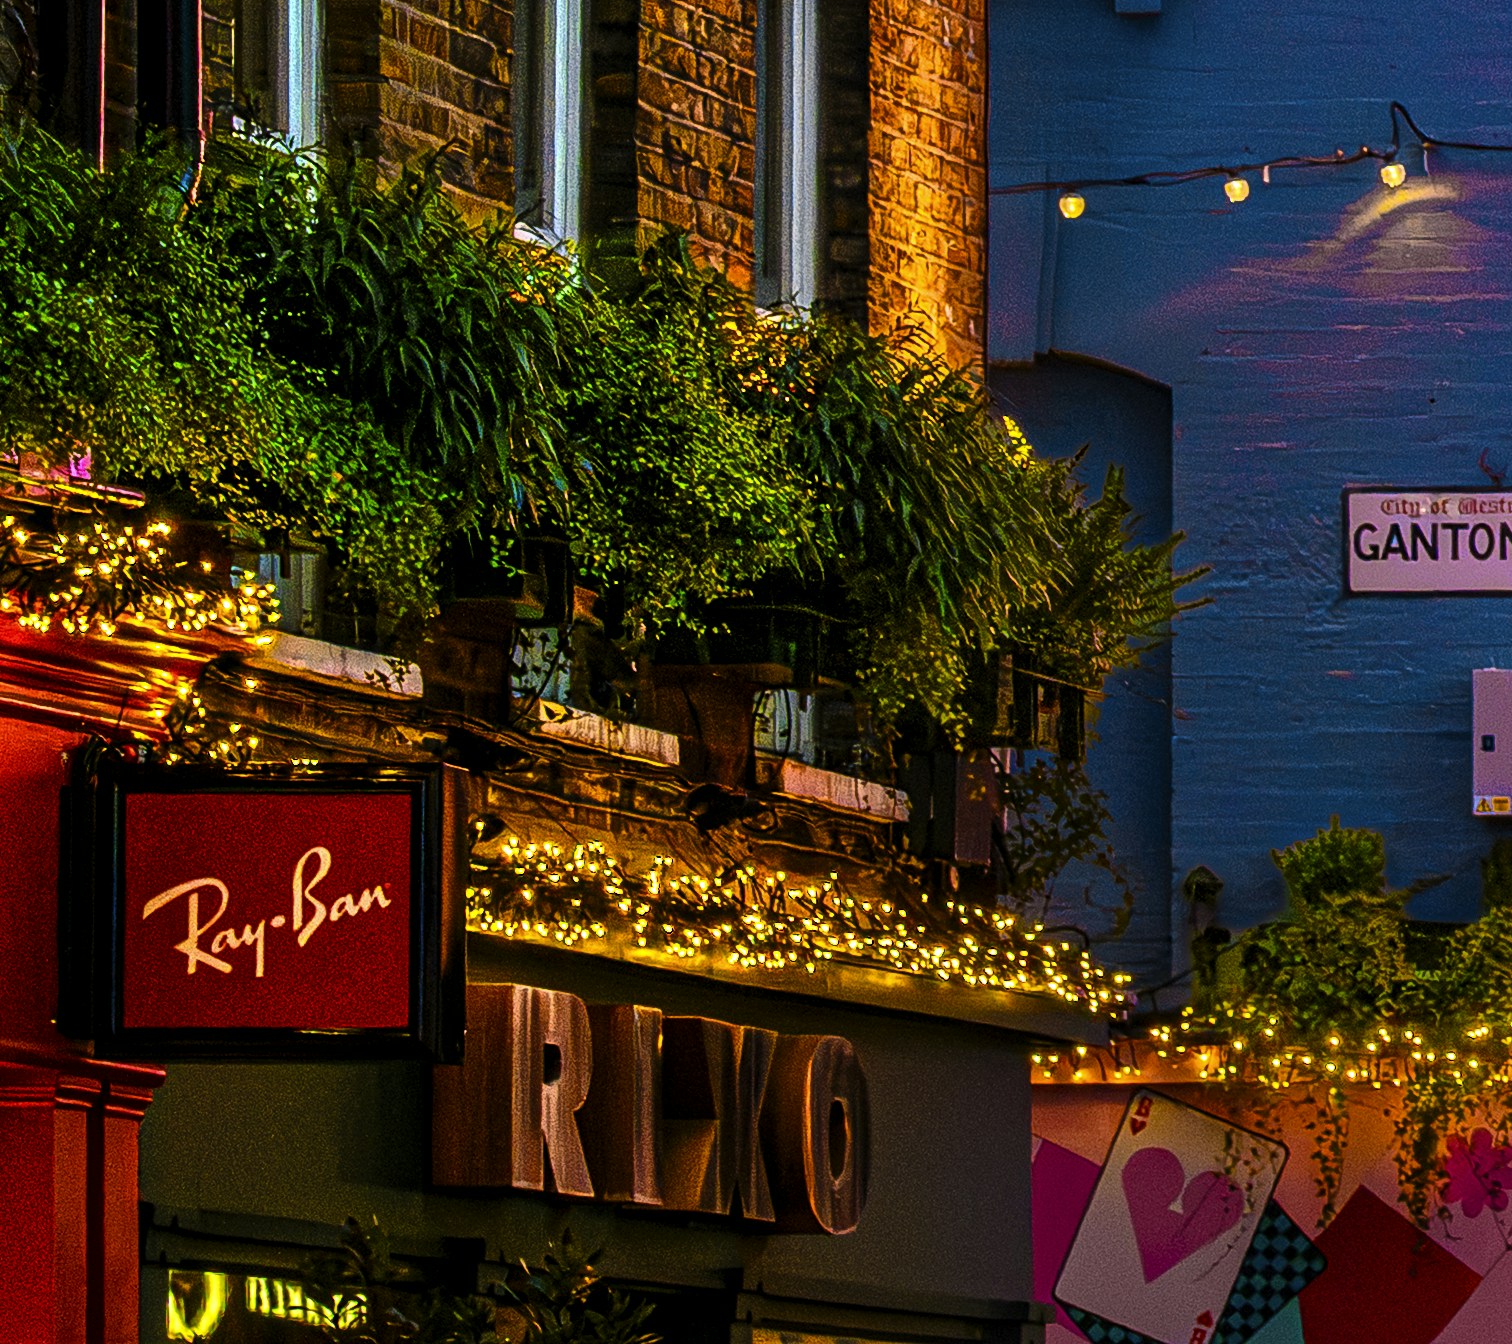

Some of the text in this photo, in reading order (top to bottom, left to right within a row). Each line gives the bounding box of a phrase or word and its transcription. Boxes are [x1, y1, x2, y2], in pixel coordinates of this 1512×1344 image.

[1380, 498, 1421, 518] City
[1430, 497, 1451, 515] of
[505, 980, 870, 1236] RIXO
